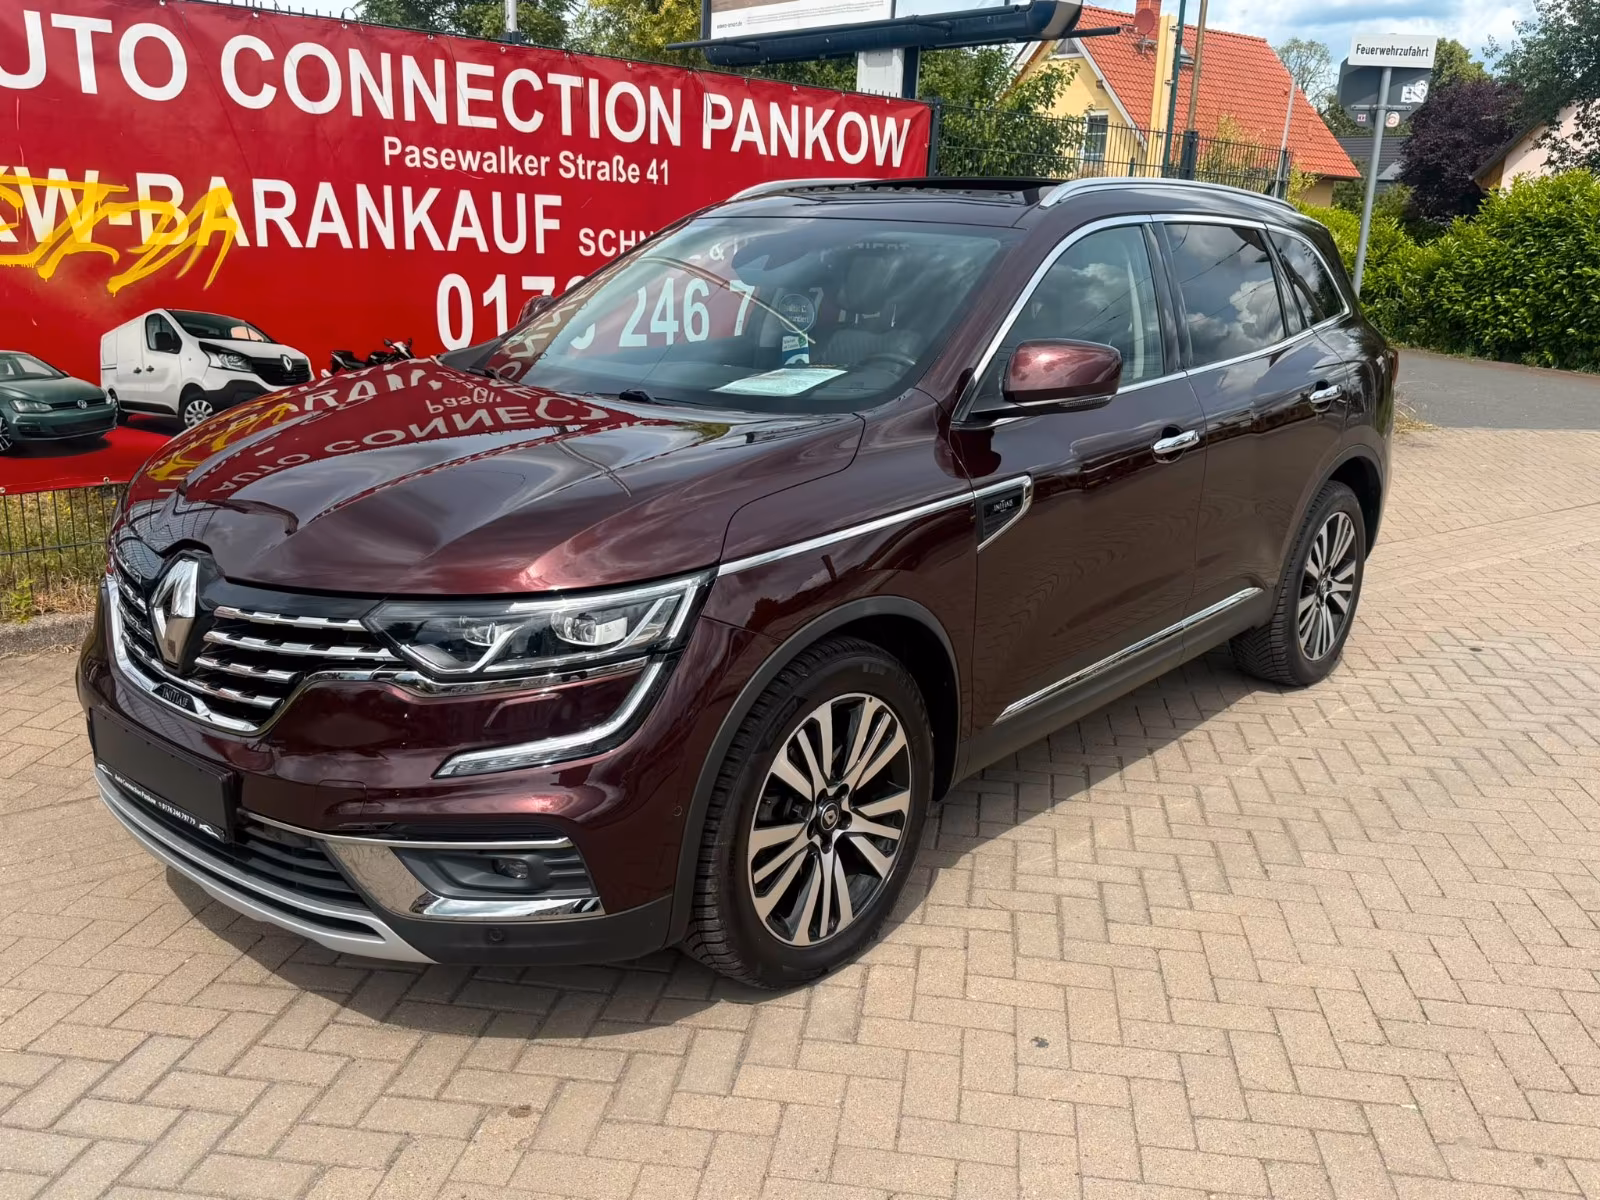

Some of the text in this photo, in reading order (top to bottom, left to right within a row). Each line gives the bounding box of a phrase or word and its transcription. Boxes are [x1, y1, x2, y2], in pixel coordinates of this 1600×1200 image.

[1356, 43, 1429, 57] Feuerwehrzufahrt
[221, 35, 682, 147] CONNECTION
[702, 93, 911, 168] PANKOW
[383, 136, 669, 185] Pasewalker Straße 41
[618, 277, 710, 347] 246
